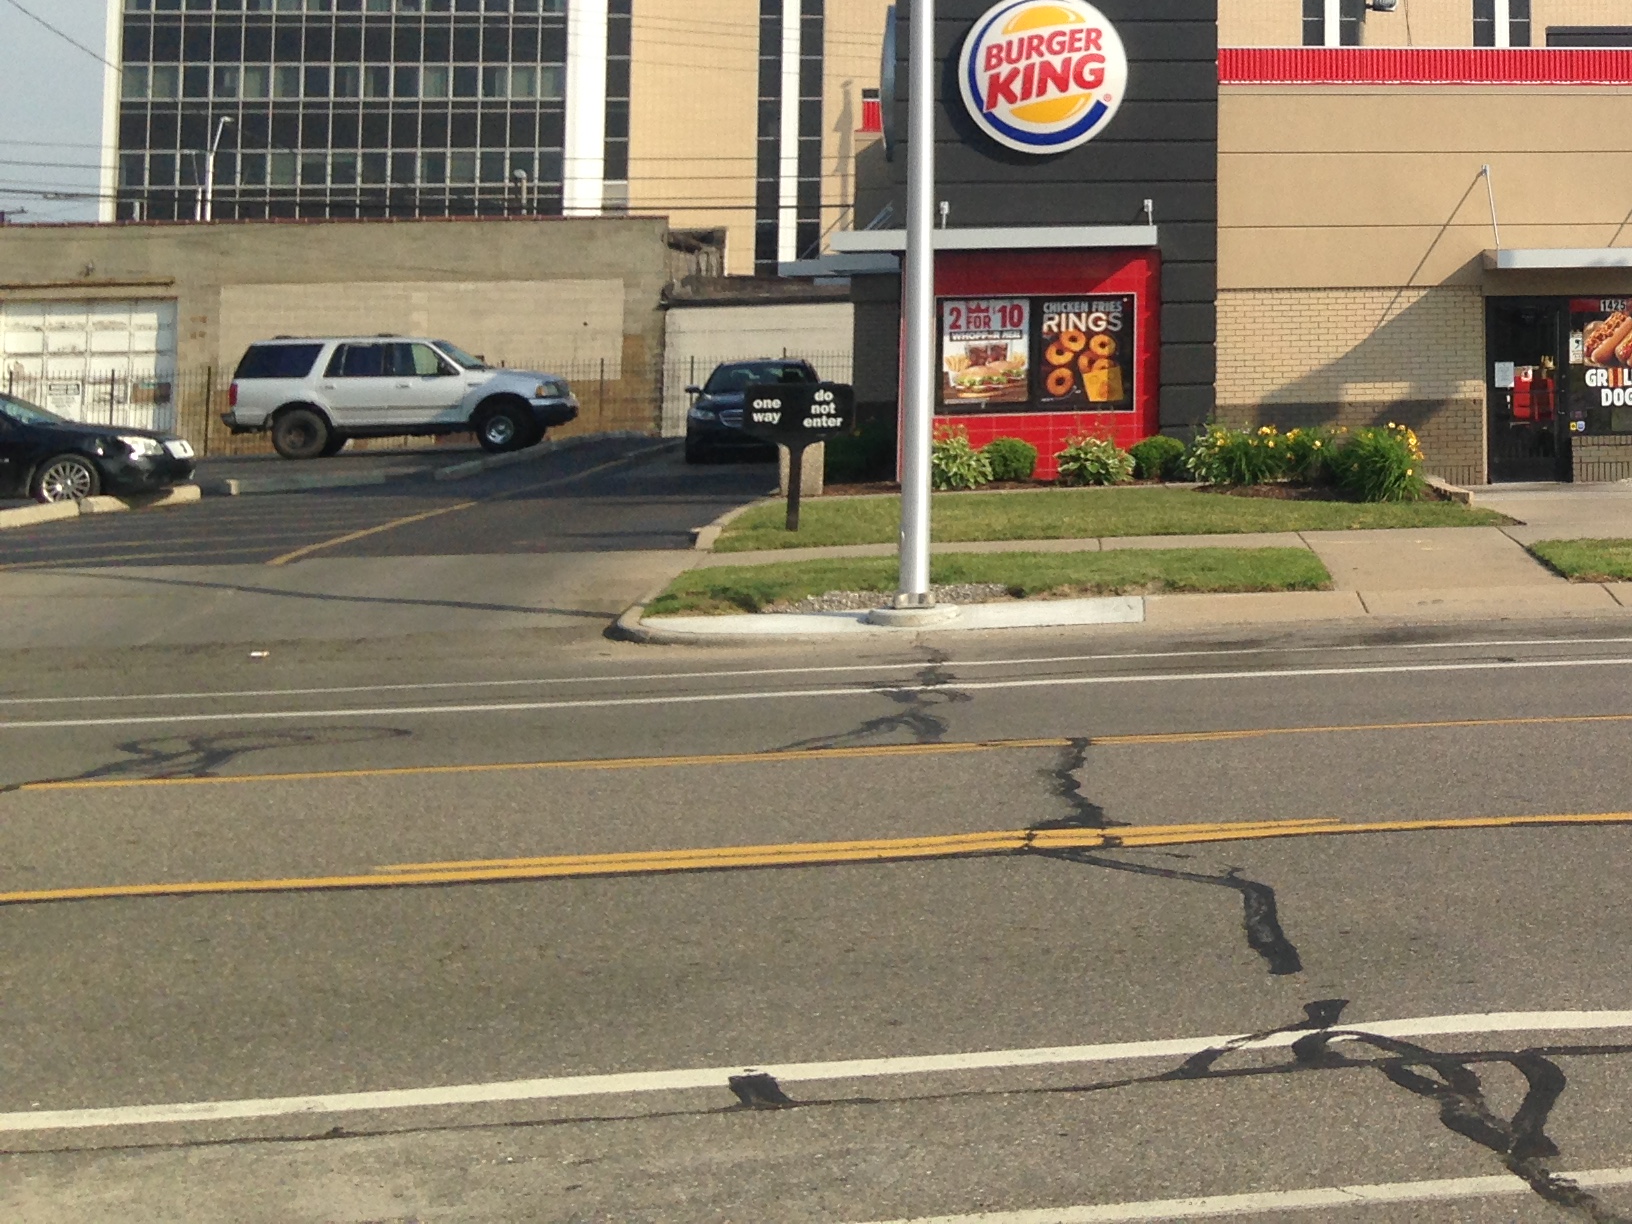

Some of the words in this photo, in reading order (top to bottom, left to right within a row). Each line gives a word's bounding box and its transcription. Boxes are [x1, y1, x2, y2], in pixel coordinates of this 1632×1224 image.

[983, 27, 1103, 73] BURGER
[983, 53, 1106, 113] KING
[1043, 302, 1088, 313] CHICKEN
[1091, 301, 1122, 312] FRIES
[1601, 299, 1626, 311] 1425
[949, 306, 962, 330] 2
[966, 315, 991, 329] FOR
[1042, 312, 1123, 333] RINGS
[814, 389, 834, 402] do
[753, 398, 782, 409] one
[811, 402, 836, 415] not
[752, 411, 782, 425] way
[803, 415, 843, 428] enter
